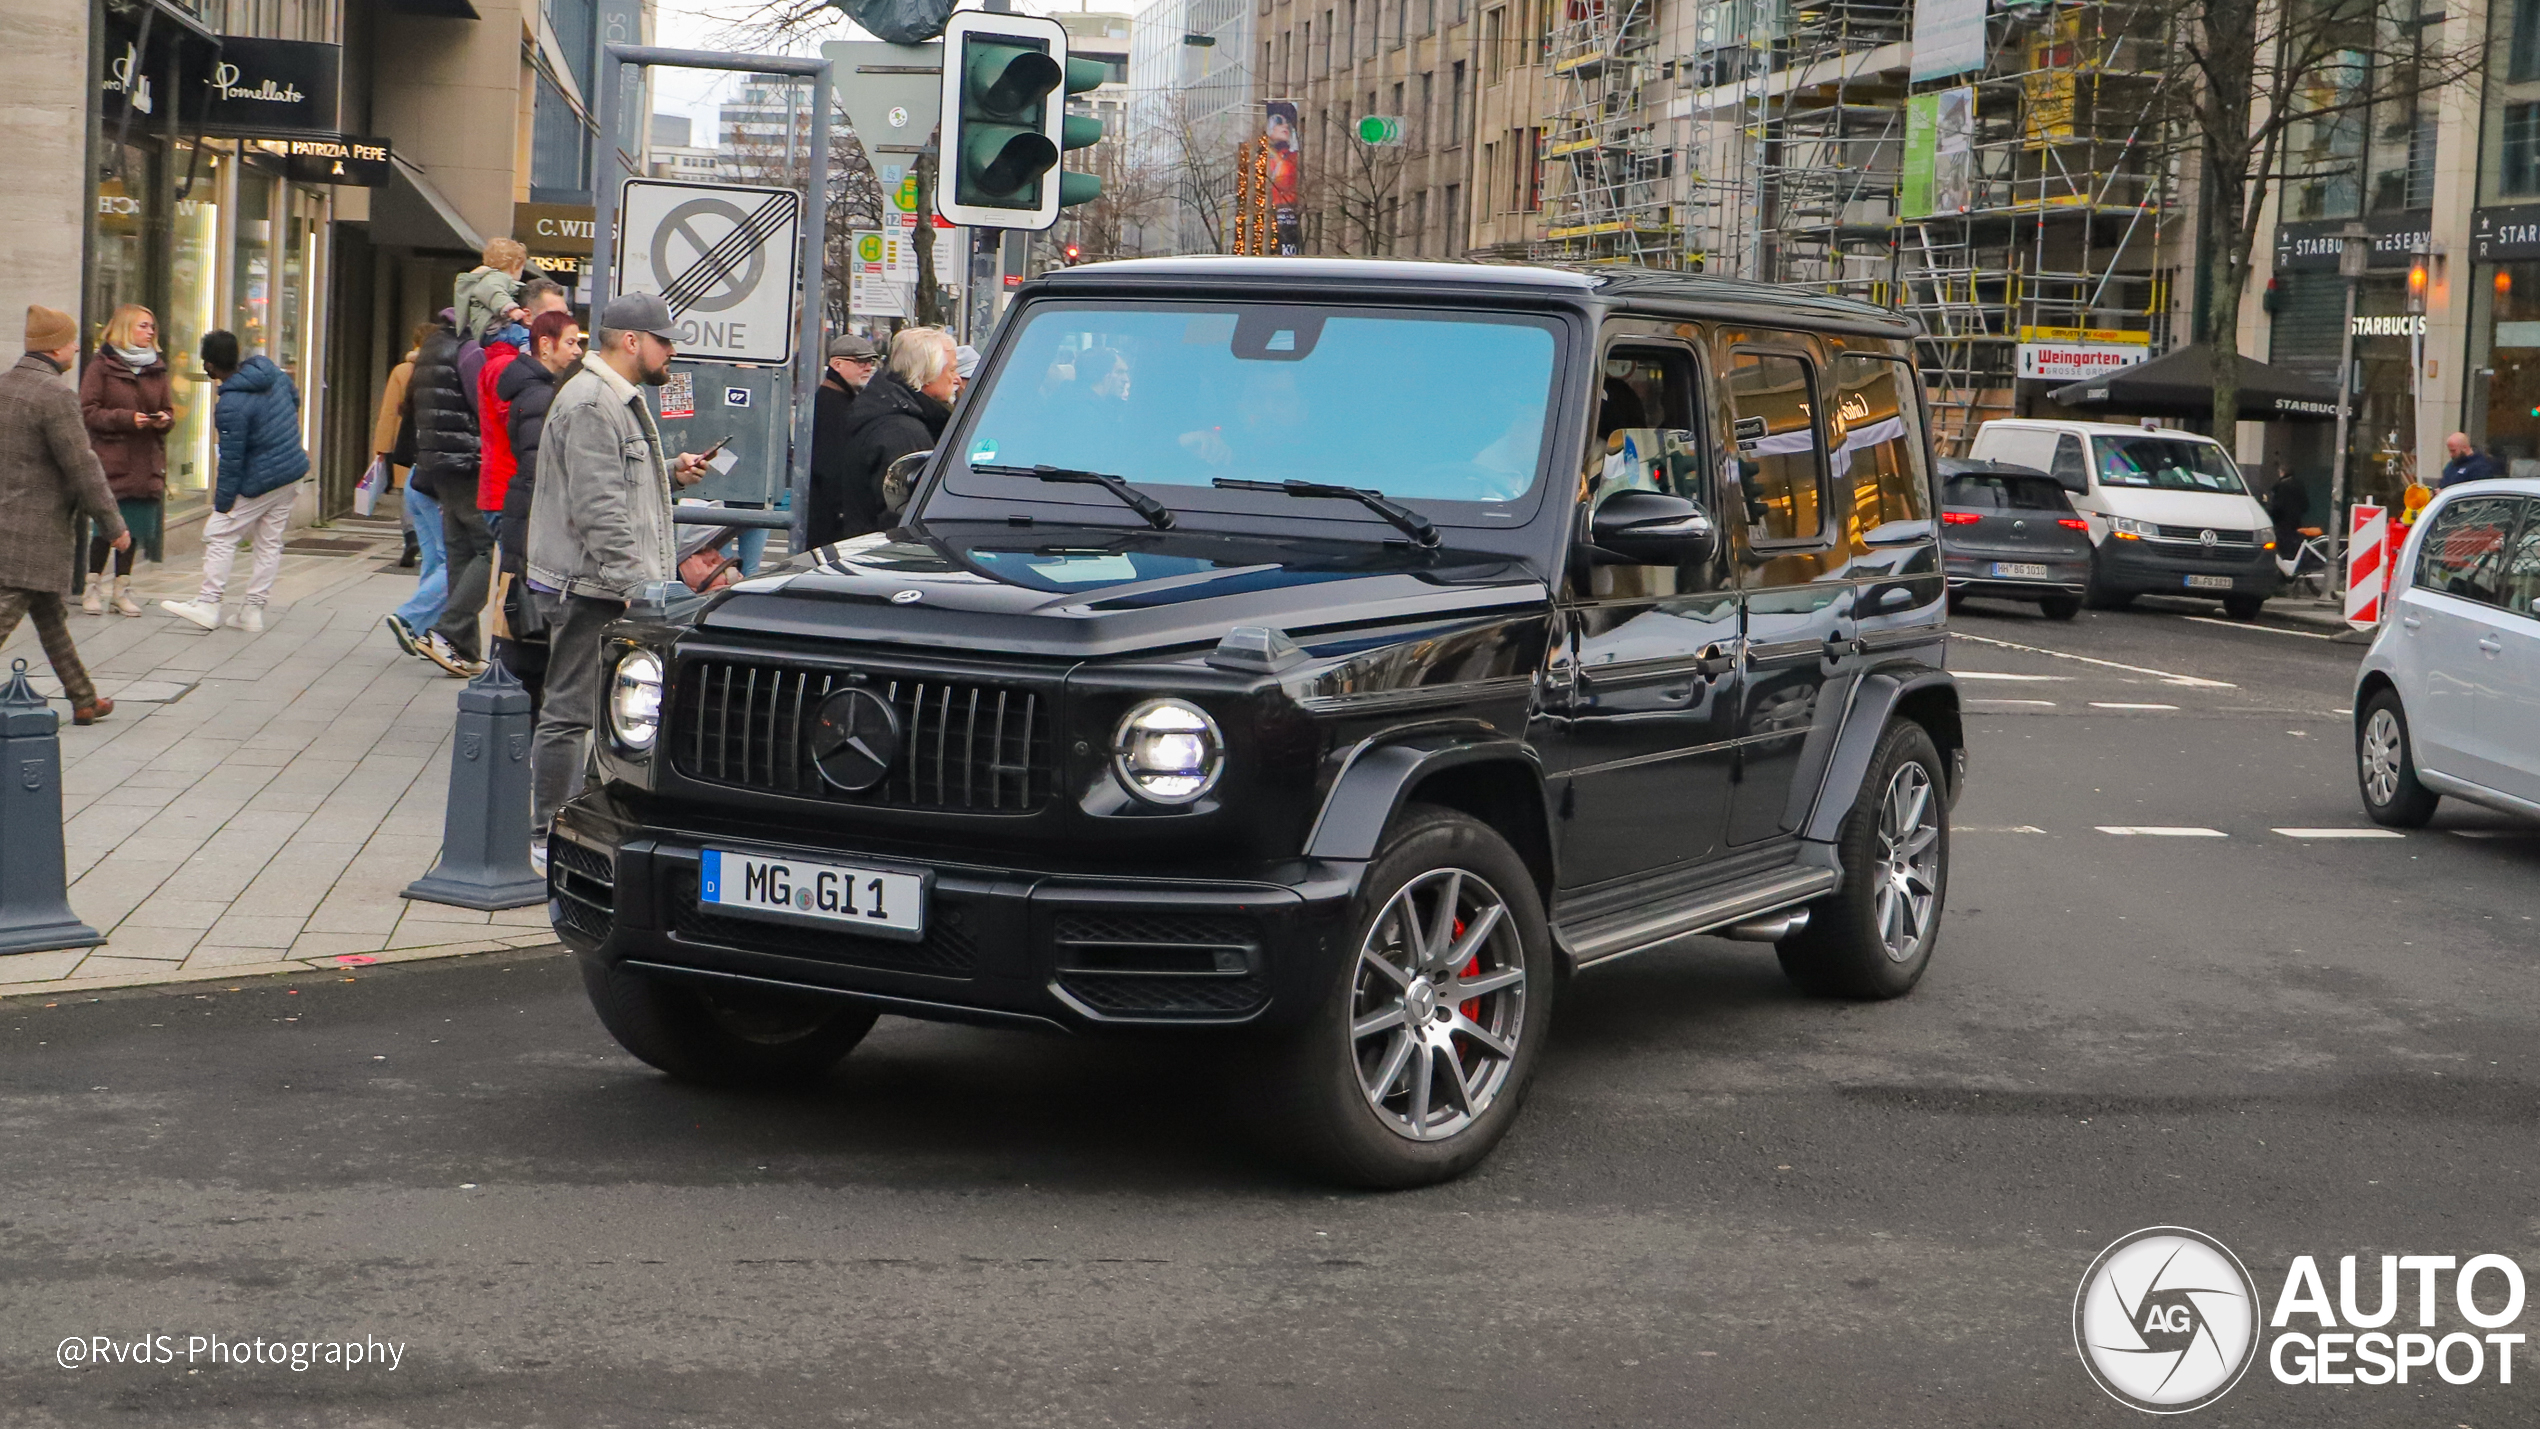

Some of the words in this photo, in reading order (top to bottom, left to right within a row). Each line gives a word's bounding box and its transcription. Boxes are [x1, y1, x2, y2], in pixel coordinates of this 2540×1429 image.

[204, 61, 305, 102] Pomellato
[291, 141, 350, 159] PATRIZIA
[353, 145, 387, 162] PEPE
[887, 214, 899, 225] 12
[2499, 223, 2540, 244] STAR
[2296, 238, 2343, 255] STARBU
[2038, 349, 2120, 368] Weingarten
[981, 439, 990, 452] 4
[707, 880, 715, 893] D
[745, 860, 791, 905] MG
[816, 870, 859, 915] GI
[867, 877, 888, 919] 1
